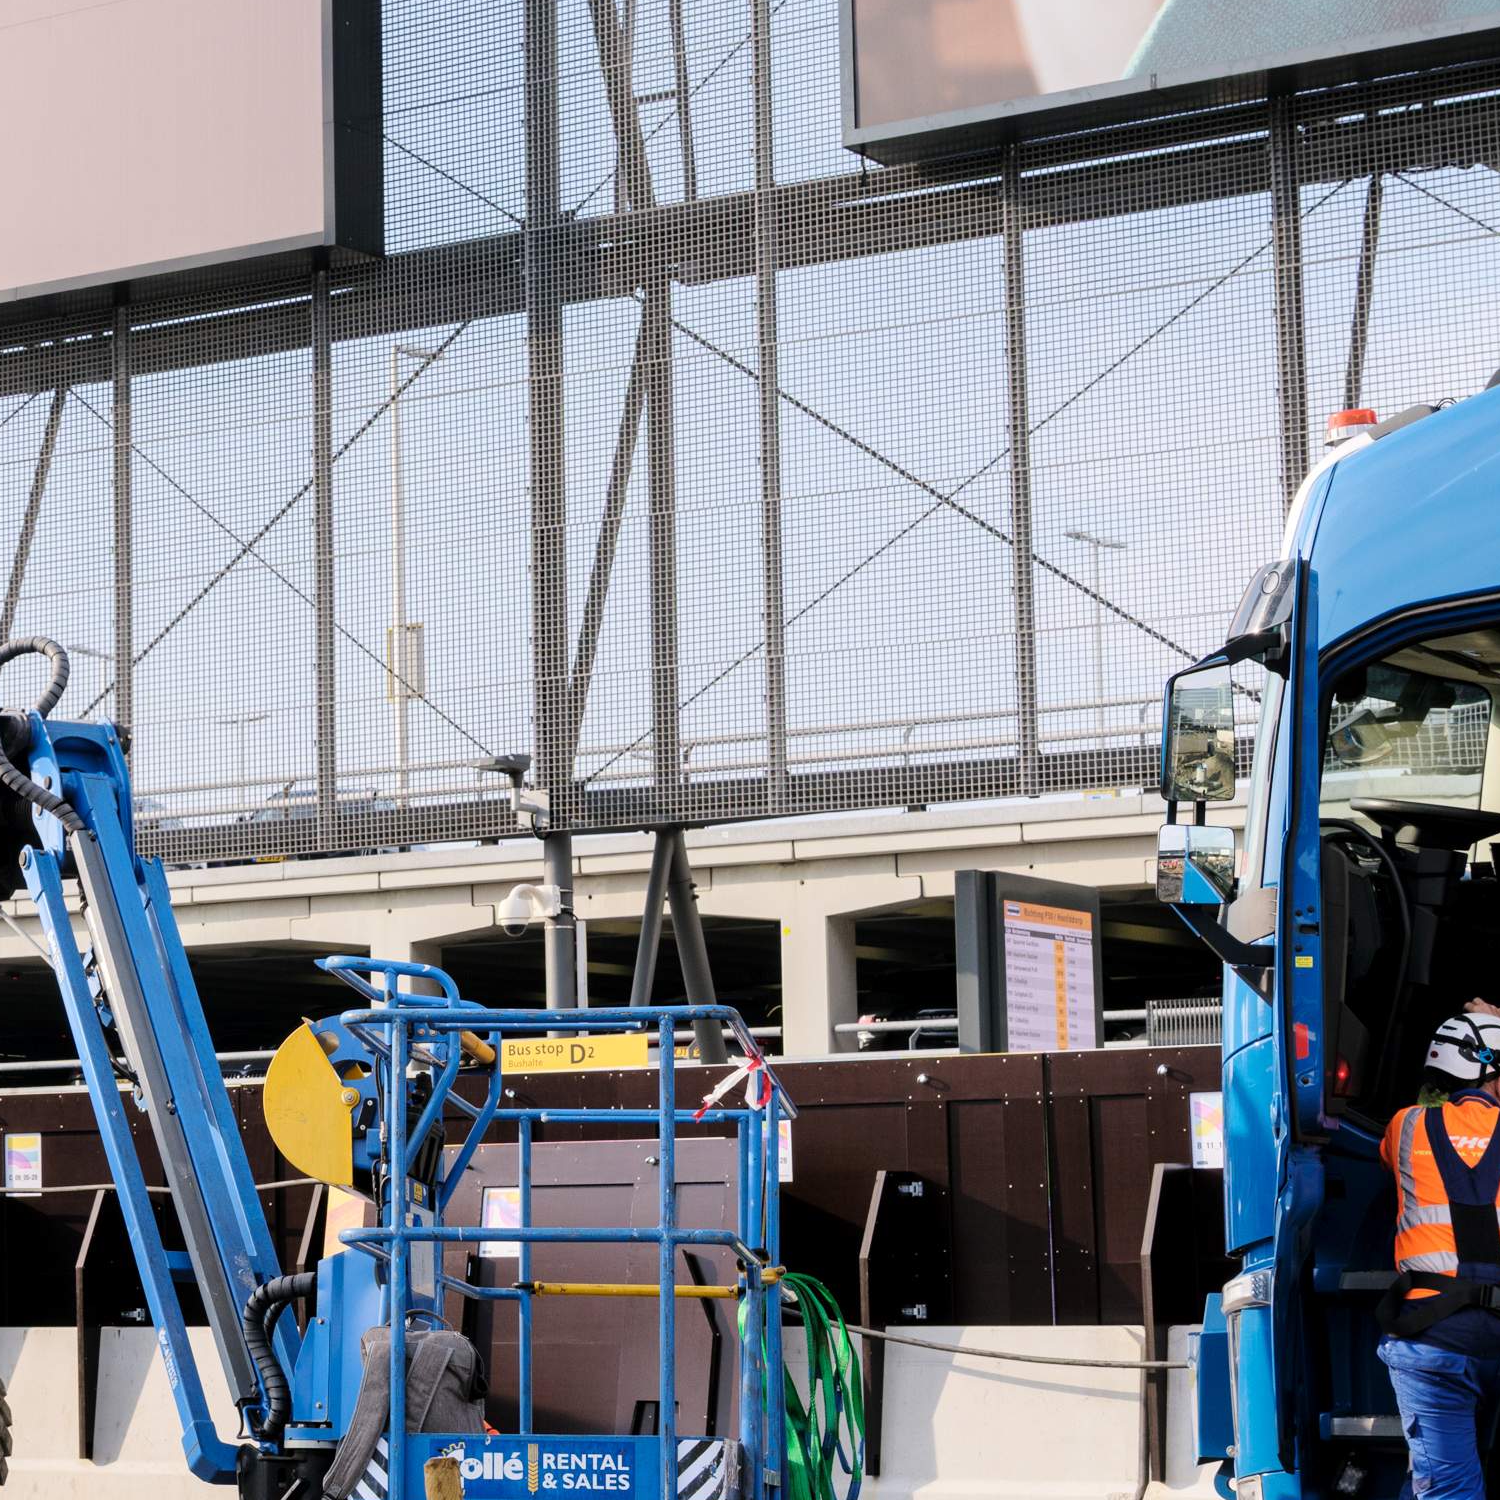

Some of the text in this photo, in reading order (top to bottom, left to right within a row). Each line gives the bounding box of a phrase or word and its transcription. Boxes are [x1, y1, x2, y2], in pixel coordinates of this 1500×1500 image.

[508, 1044, 531, 1055] Bus
[535, 1043, 563, 1056] stop
[508, 1058, 543, 1068] Bushalte
[543, 1453, 630, 1471] RENTAL
[542, 1473, 631, 1491] & SALES
